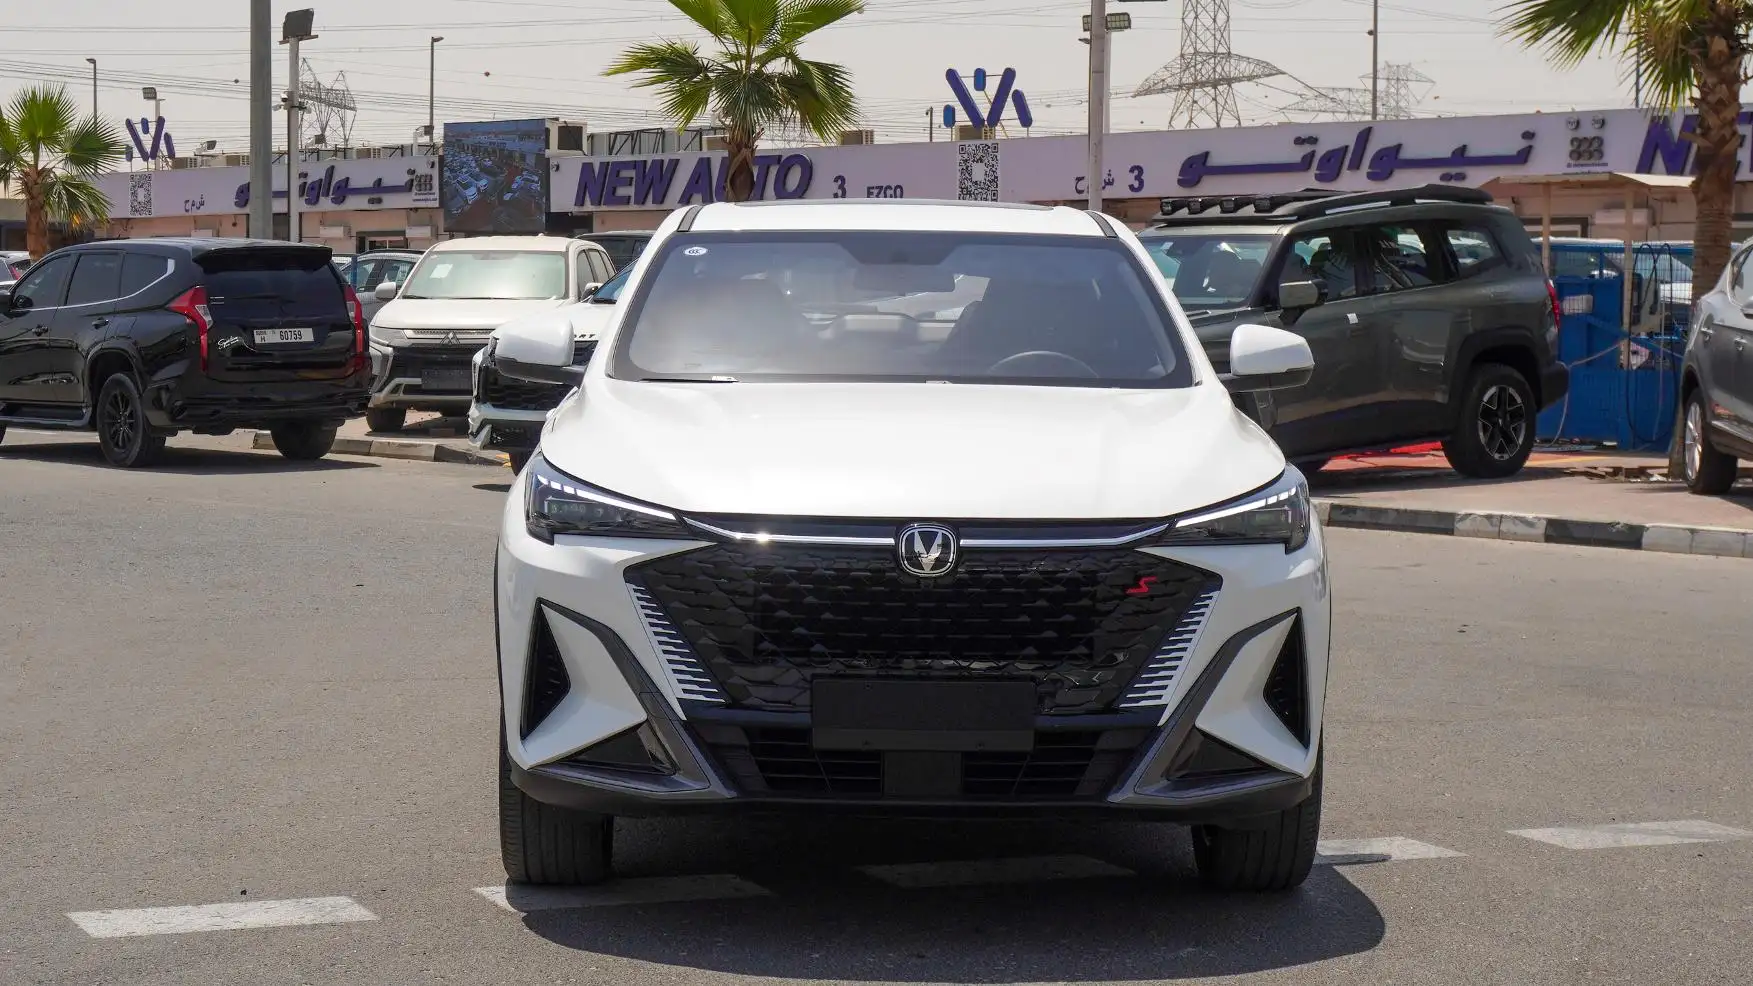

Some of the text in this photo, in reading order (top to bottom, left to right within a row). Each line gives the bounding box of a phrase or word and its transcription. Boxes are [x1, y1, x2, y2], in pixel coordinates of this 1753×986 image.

[574, 159, 680, 206] NEW
[833, 175, 847, 198] 3
[1128, 165, 1144, 192] 3
[279, 330, 303, 342] 60759
[1126, 575, 1158, 594] S
